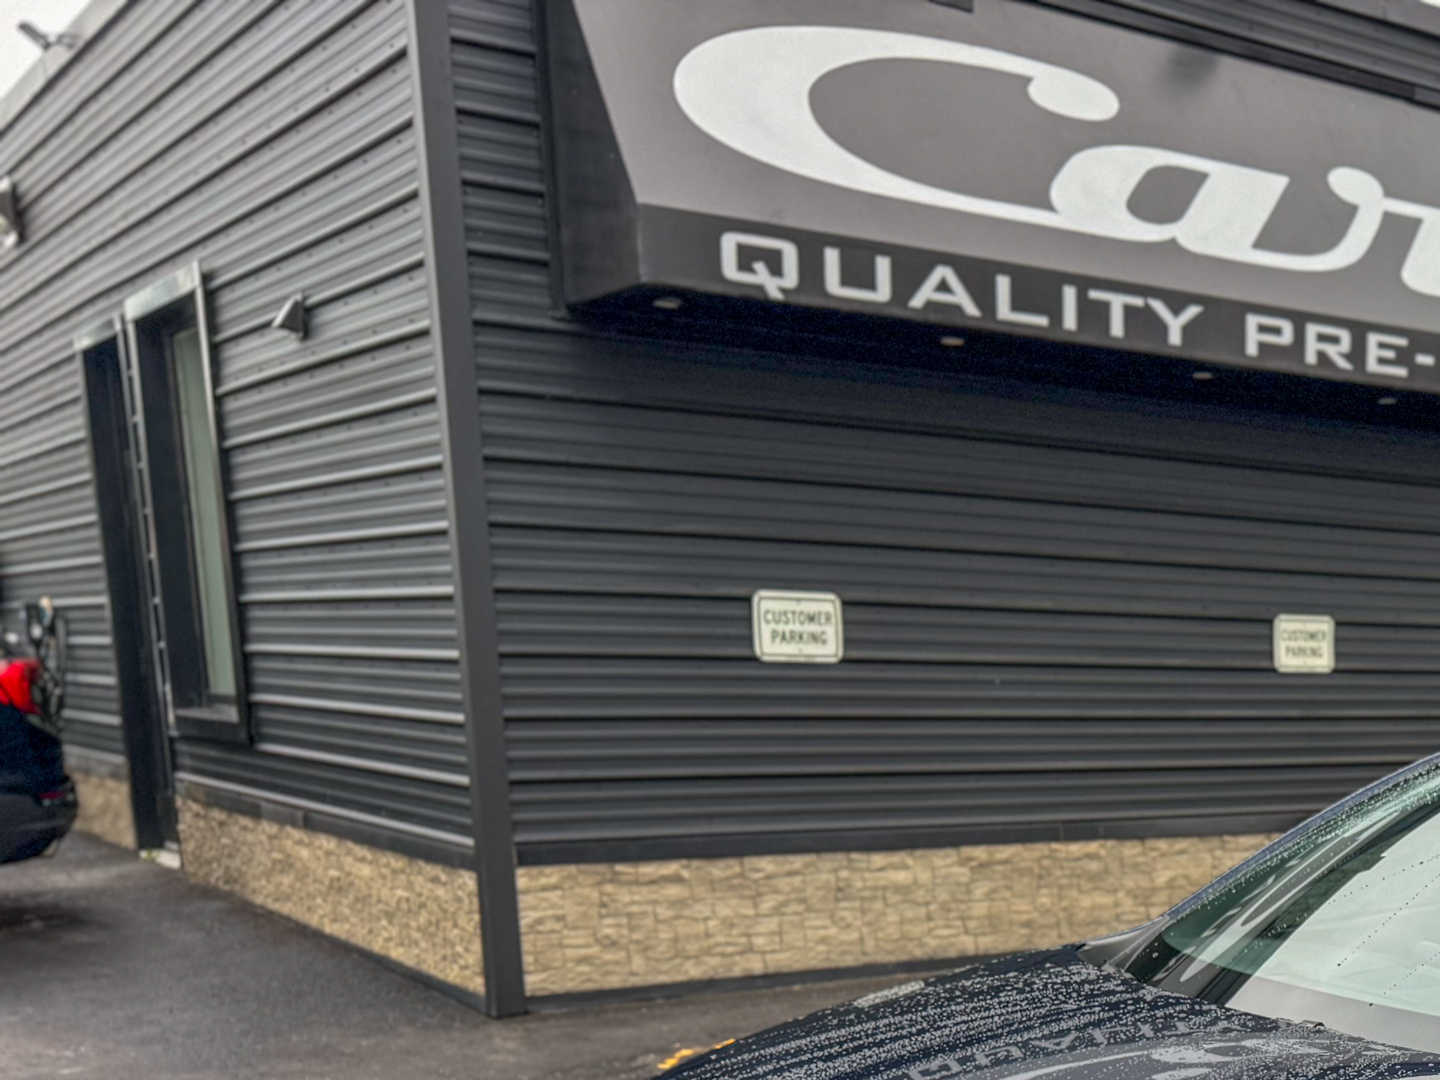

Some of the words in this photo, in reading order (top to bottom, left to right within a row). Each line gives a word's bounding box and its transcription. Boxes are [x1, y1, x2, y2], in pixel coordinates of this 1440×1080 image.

[719, 230, 1204, 347] QUALITY
[763, 609, 833, 626] CUSTOMER
[770, 629, 828, 645] PARKING
